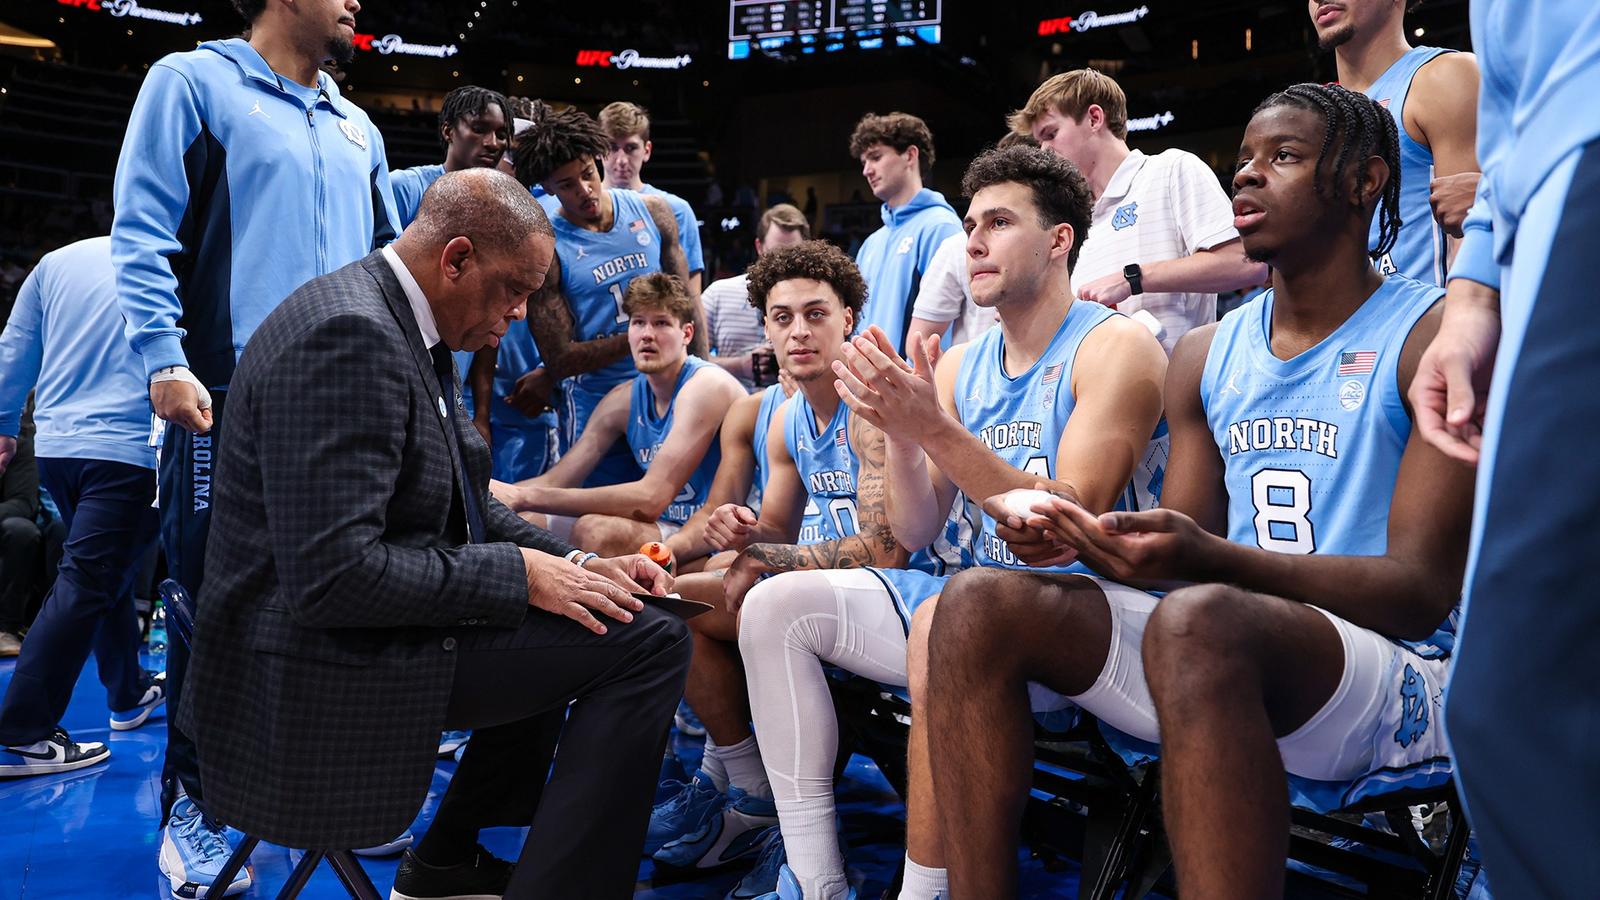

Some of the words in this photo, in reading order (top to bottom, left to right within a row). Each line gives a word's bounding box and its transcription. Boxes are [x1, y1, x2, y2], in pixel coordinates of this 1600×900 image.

[352, 33, 375, 51] FC
[1037, 16, 1072, 36] UFC
[576, 49, 613, 67] UFC
[592, 252, 649, 285] NORTH
[981, 420, 1042, 451] NORTH
[1229, 416, 1339, 460] NORTH
[192, 430, 212, 512] ROLINA
[1251, 467, 1317, 556] 8
[983, 531, 1029, 567] ARO
